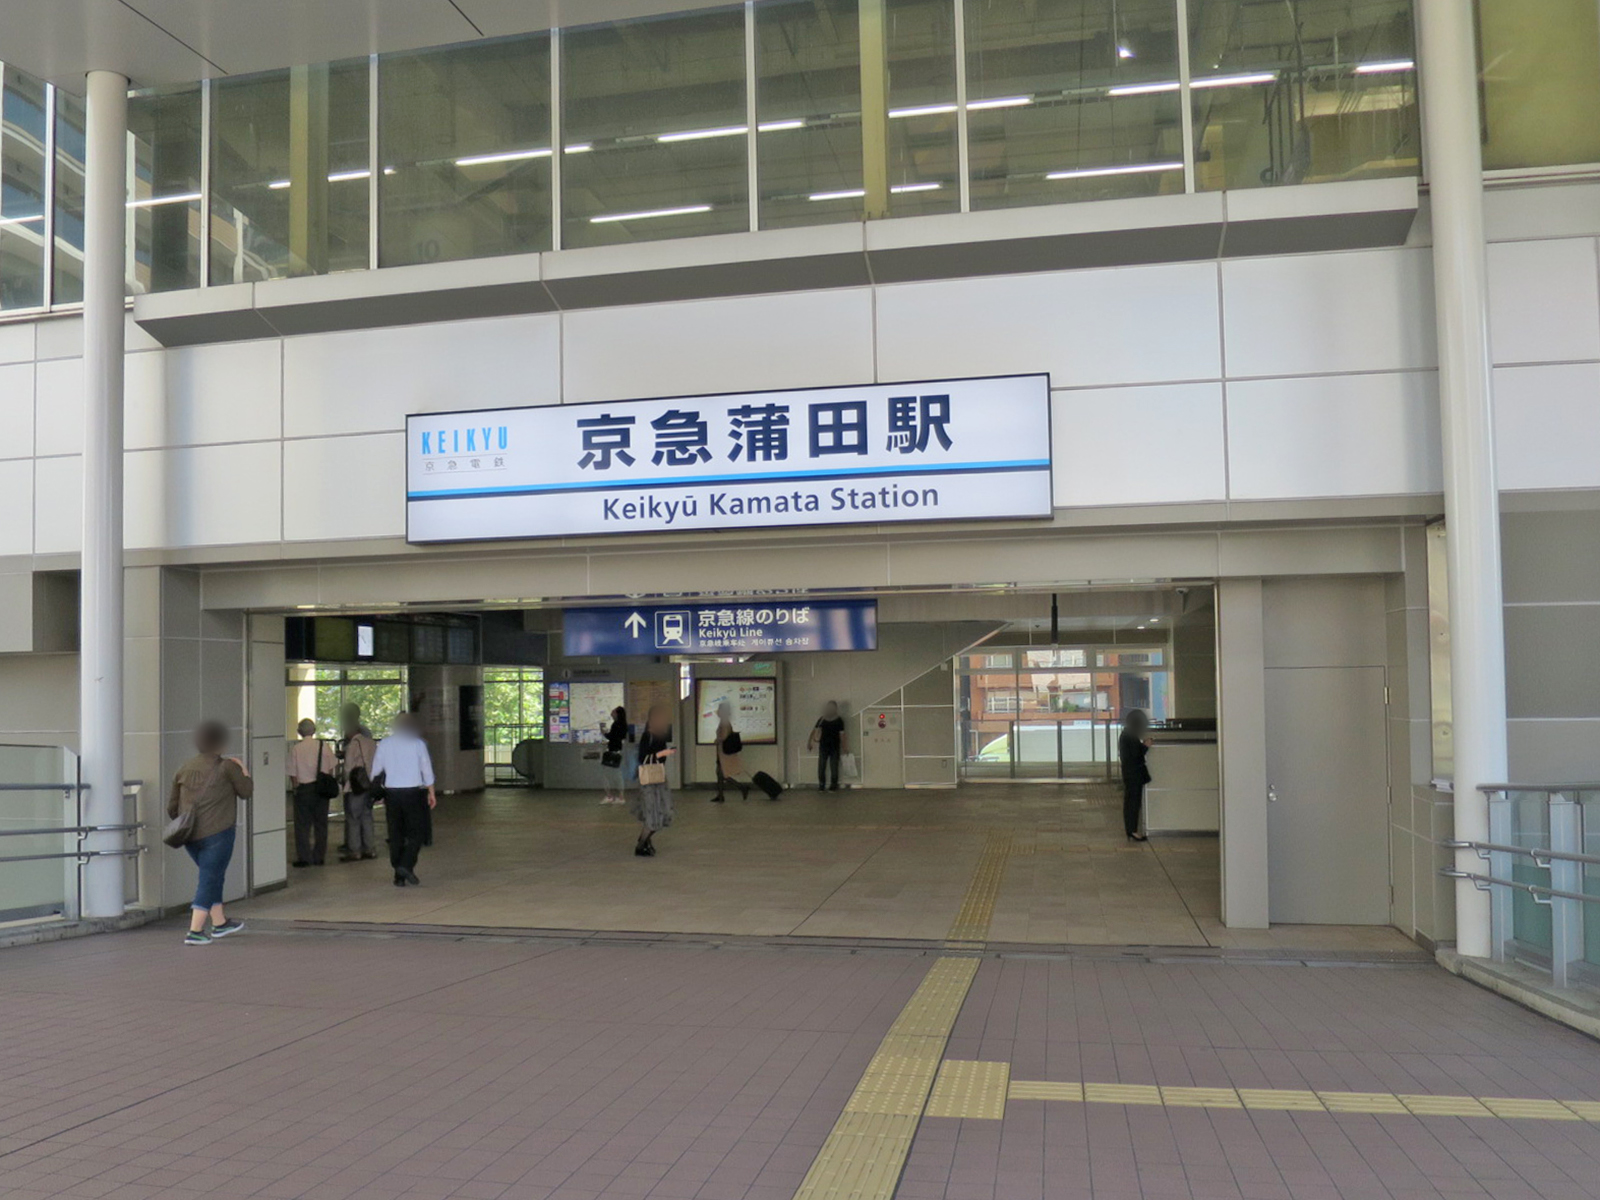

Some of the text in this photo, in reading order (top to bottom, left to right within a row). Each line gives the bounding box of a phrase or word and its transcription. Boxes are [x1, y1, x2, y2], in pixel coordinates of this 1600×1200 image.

[422, 426, 508, 454] KEIKYU
[576, 394, 953, 470] 京急蒲田駅
[425, 457, 505, 471] 京急電鉄
[603, 483, 939, 524] Keikyū Kamata Station
[697, 607, 810, 627] 京急線のりば
[740, 627, 763, 637] Line
